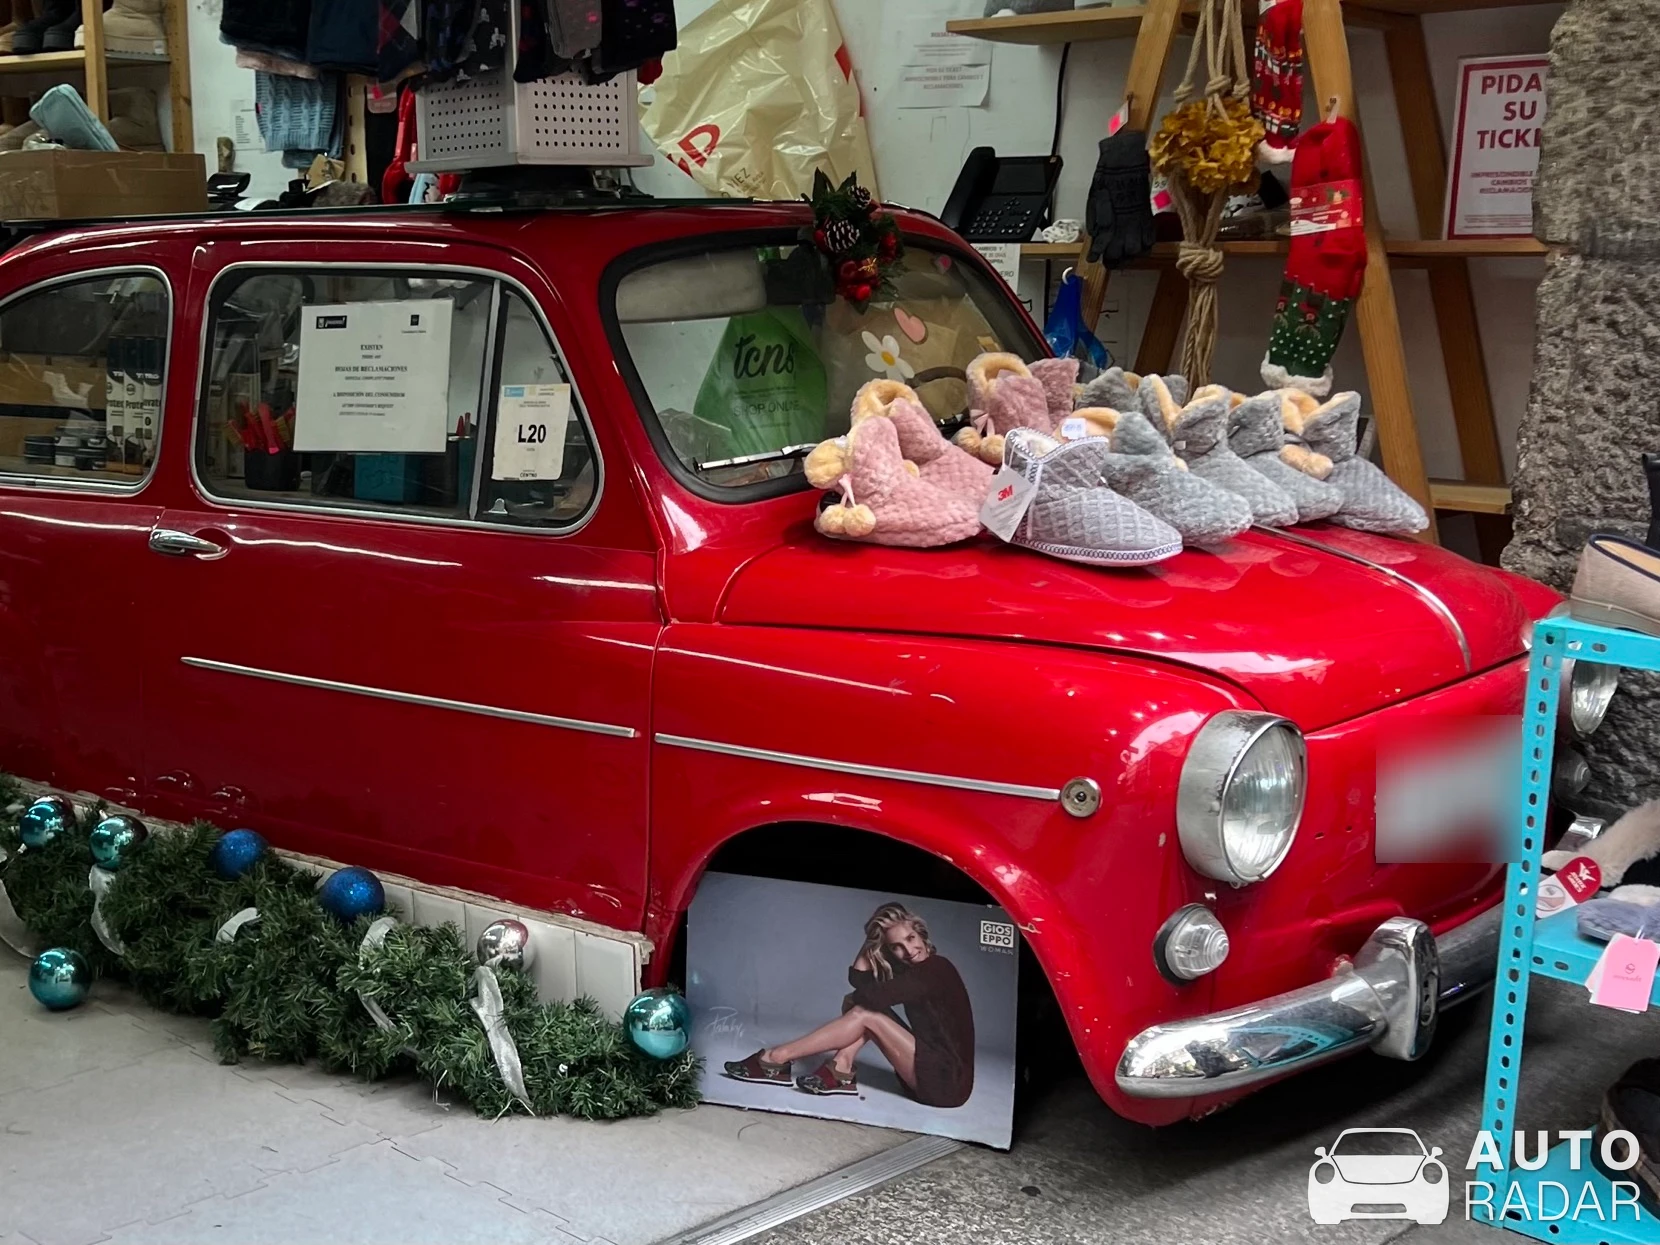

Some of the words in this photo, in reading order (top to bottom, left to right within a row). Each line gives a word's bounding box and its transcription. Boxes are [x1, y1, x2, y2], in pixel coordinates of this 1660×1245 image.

[1481, 73, 1542, 94] PIDA
[1503, 101, 1537, 121] SU
[518, 424, 546, 443] L20
[998, 485, 1013, 501] 3M
[983, 923, 1011, 936] GIOS
[983, 934, 1011, 945] EPPO
